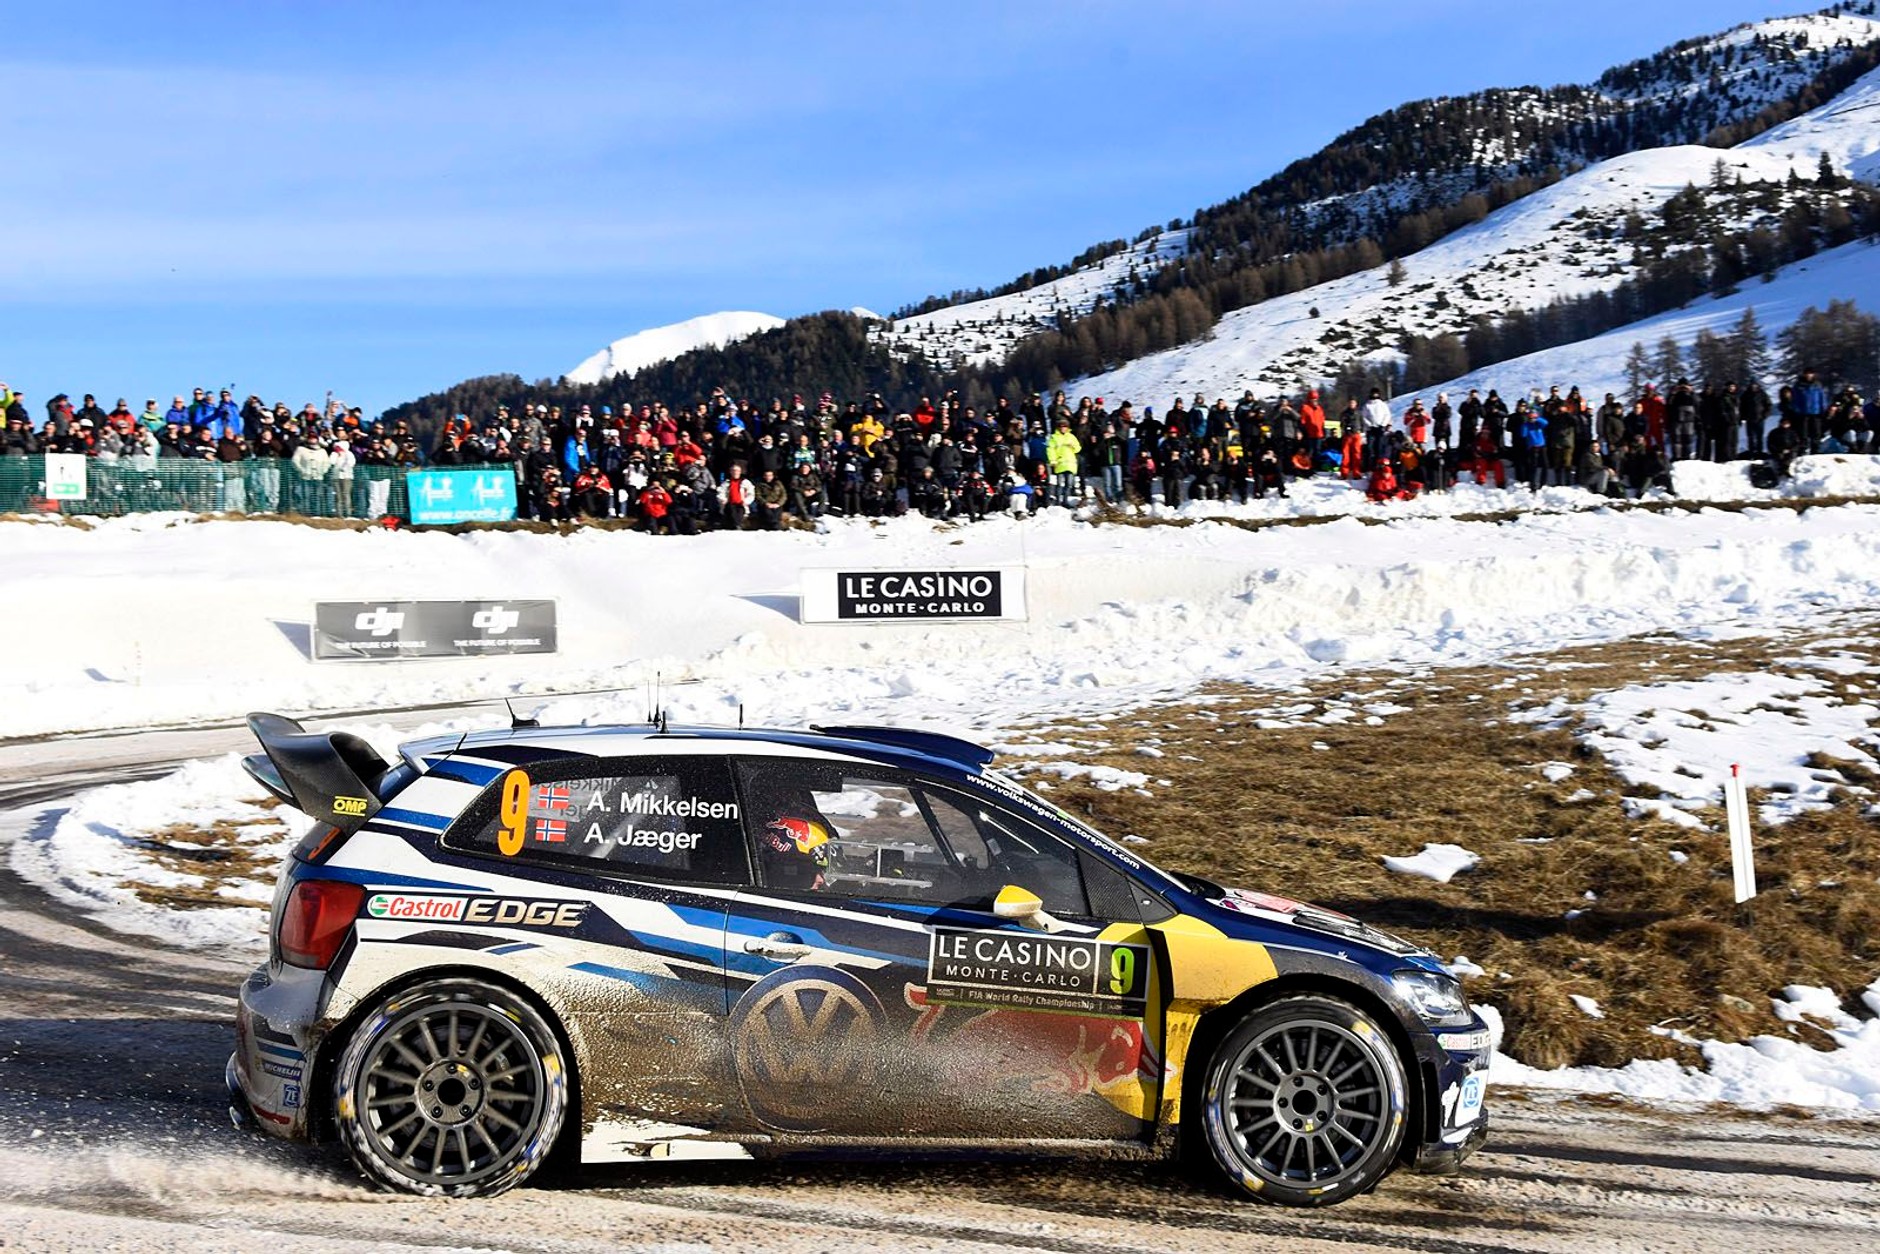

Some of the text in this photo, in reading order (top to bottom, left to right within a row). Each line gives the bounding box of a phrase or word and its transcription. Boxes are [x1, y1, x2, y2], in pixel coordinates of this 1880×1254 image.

[846, 576, 993, 598] LE CASINO
[333, 799, 367, 813] OMP
[498, 769, 530, 856] 9
[586, 790, 738, 819] A. Mikkelsen
[966, 773, 1140, 870] www.volkswagen-motorsport.com
[583, 822, 702, 853] A. Jæger
[389, 897, 587, 927] Castrol EDGE
[938, 935, 1091, 970] LE CASINO
[1109, 947, 1135, 995] 9
[968, 990, 983, 999] FIA
[985, 991, 1011, 1002] World
[1013, 994, 1034, 1006] Rally
[1035, 996, 1095, 1010] Championship
